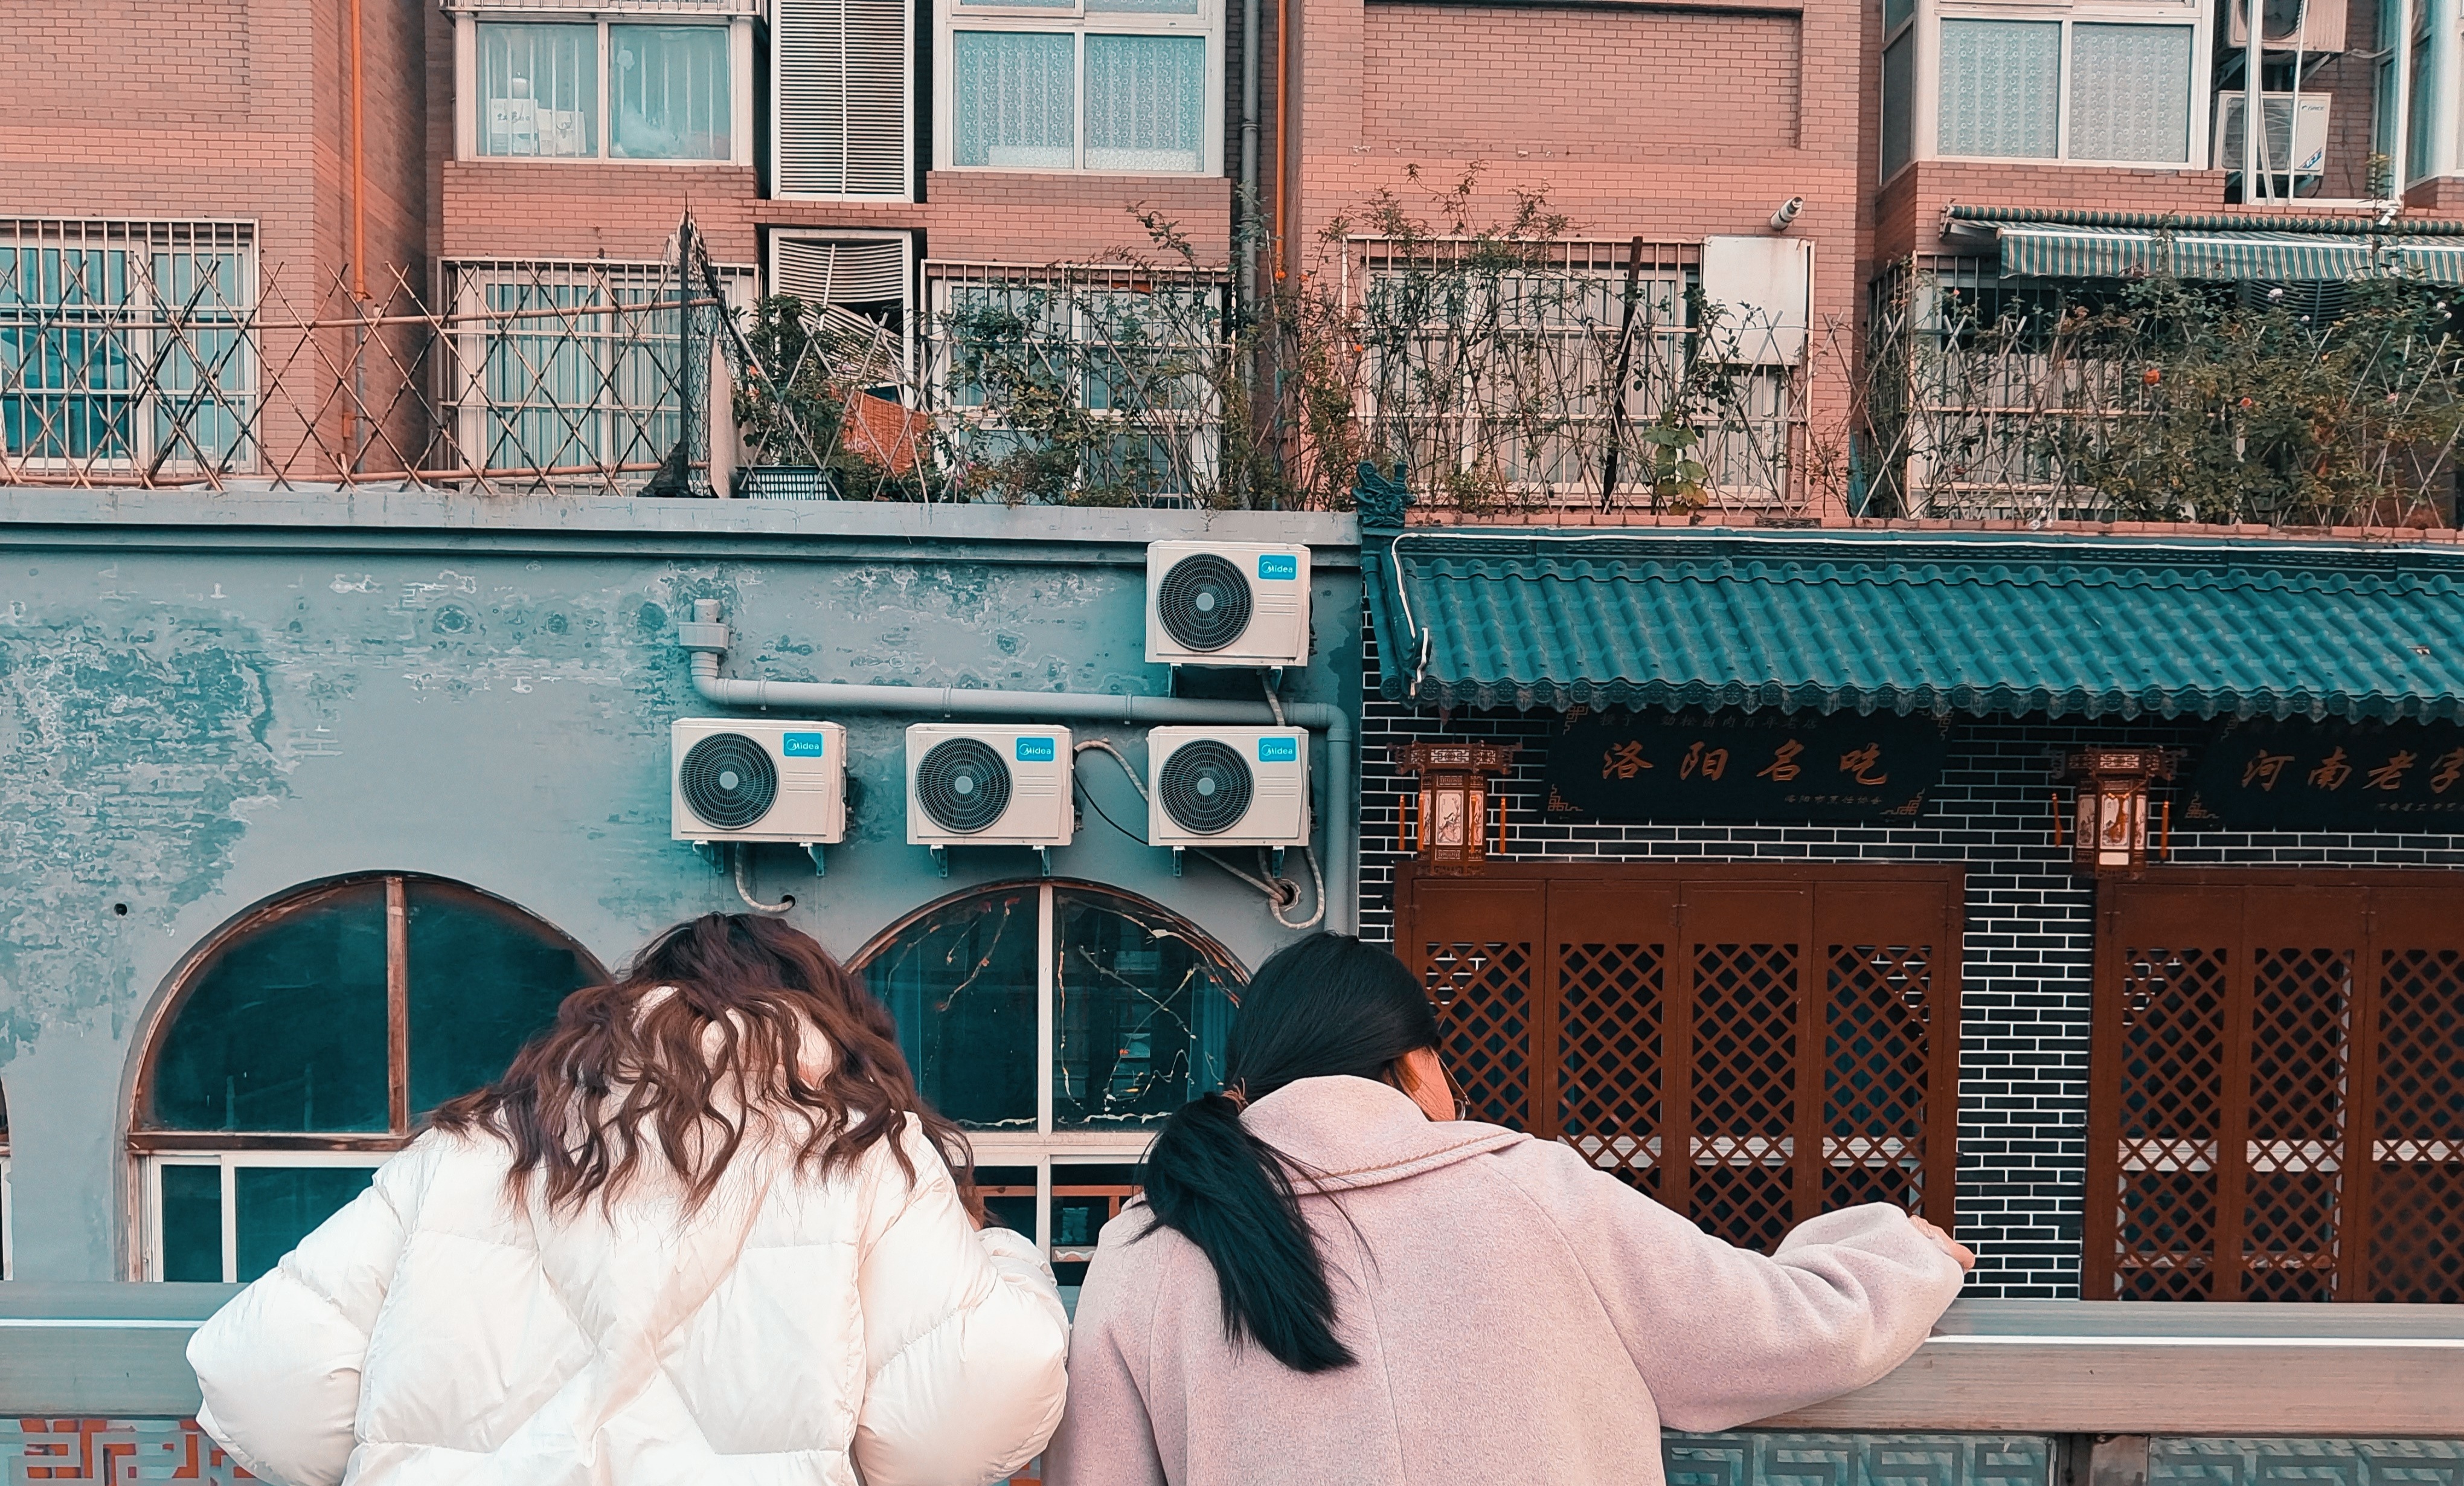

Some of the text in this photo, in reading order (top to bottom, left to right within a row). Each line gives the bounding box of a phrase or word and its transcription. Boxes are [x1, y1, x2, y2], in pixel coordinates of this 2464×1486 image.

[1261, 561, 1293, 574] Midea
[786, 738, 820, 751] Midea
[1019, 743, 1051, 756] Midea
[1261, 744, 1293, 756] Midea
[1602, 738, 1888, 785] 洛阳名吃
